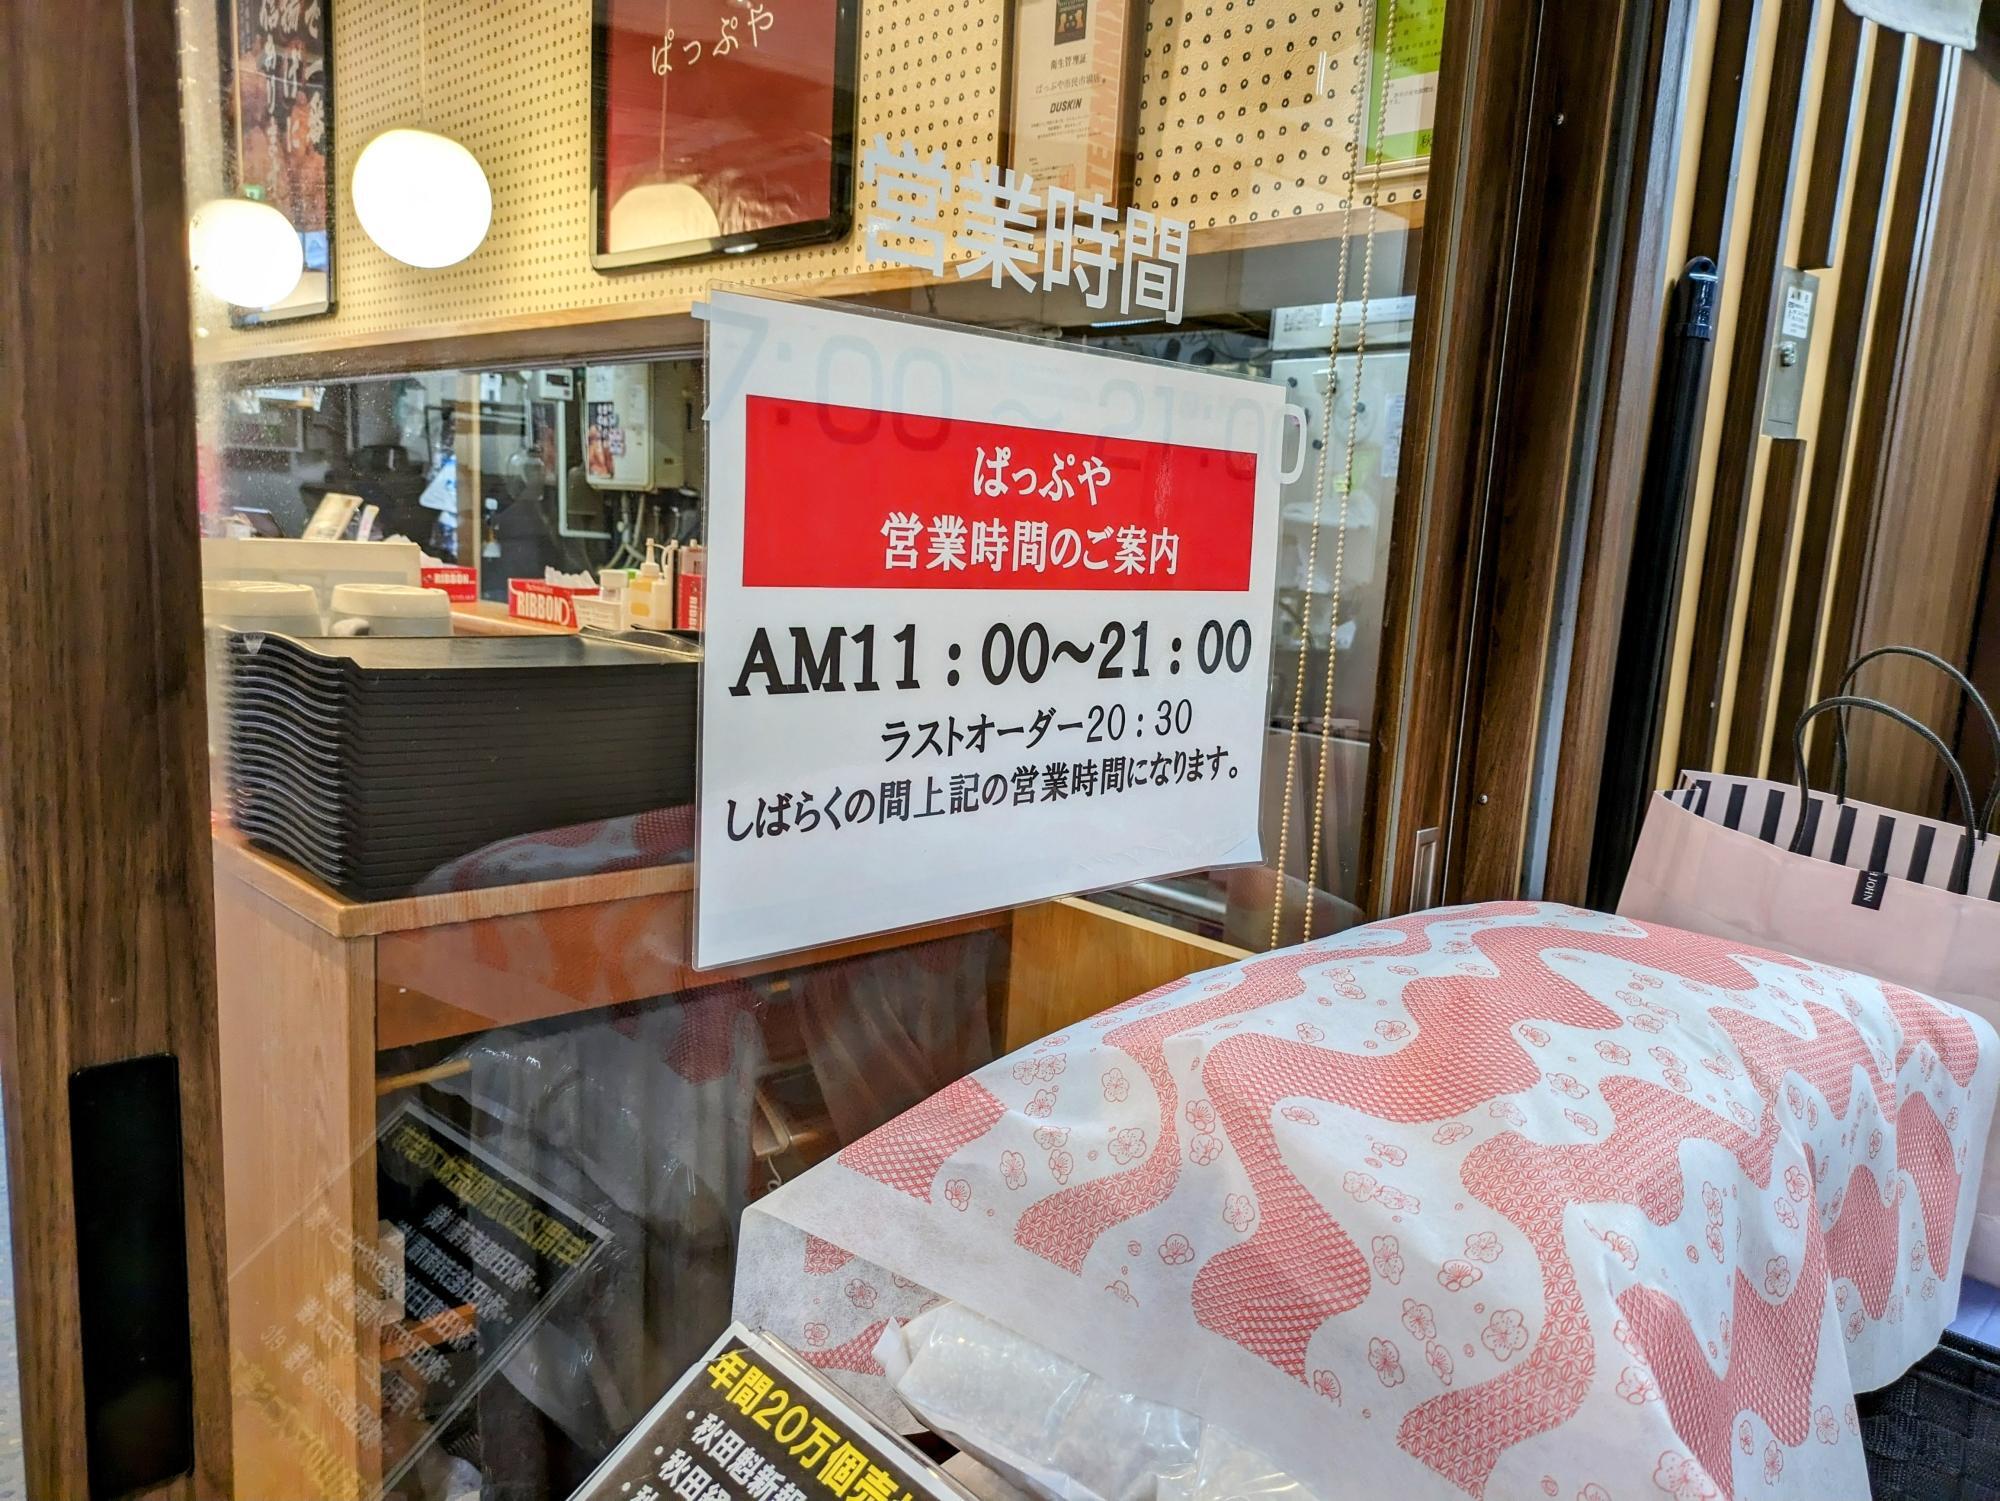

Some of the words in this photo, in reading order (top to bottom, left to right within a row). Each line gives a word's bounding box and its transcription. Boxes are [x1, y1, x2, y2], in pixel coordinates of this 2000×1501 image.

[651, 4, 774, 76] ぱっぷや
[1049, 98, 1082, 114] DUSKIN
[863, 132, 1189, 325] 営業時間
[973, 446, 1112, 505] ぱっぷや
[880, 511, 1179, 575] 営業時間のご案内
[516, 590, 570, 626] RIBBON
[881, 699, 1193, 762] ラストオーダー20：30
[727, 745, 1238, 841] しばらくの間上記の営業時間になります。
